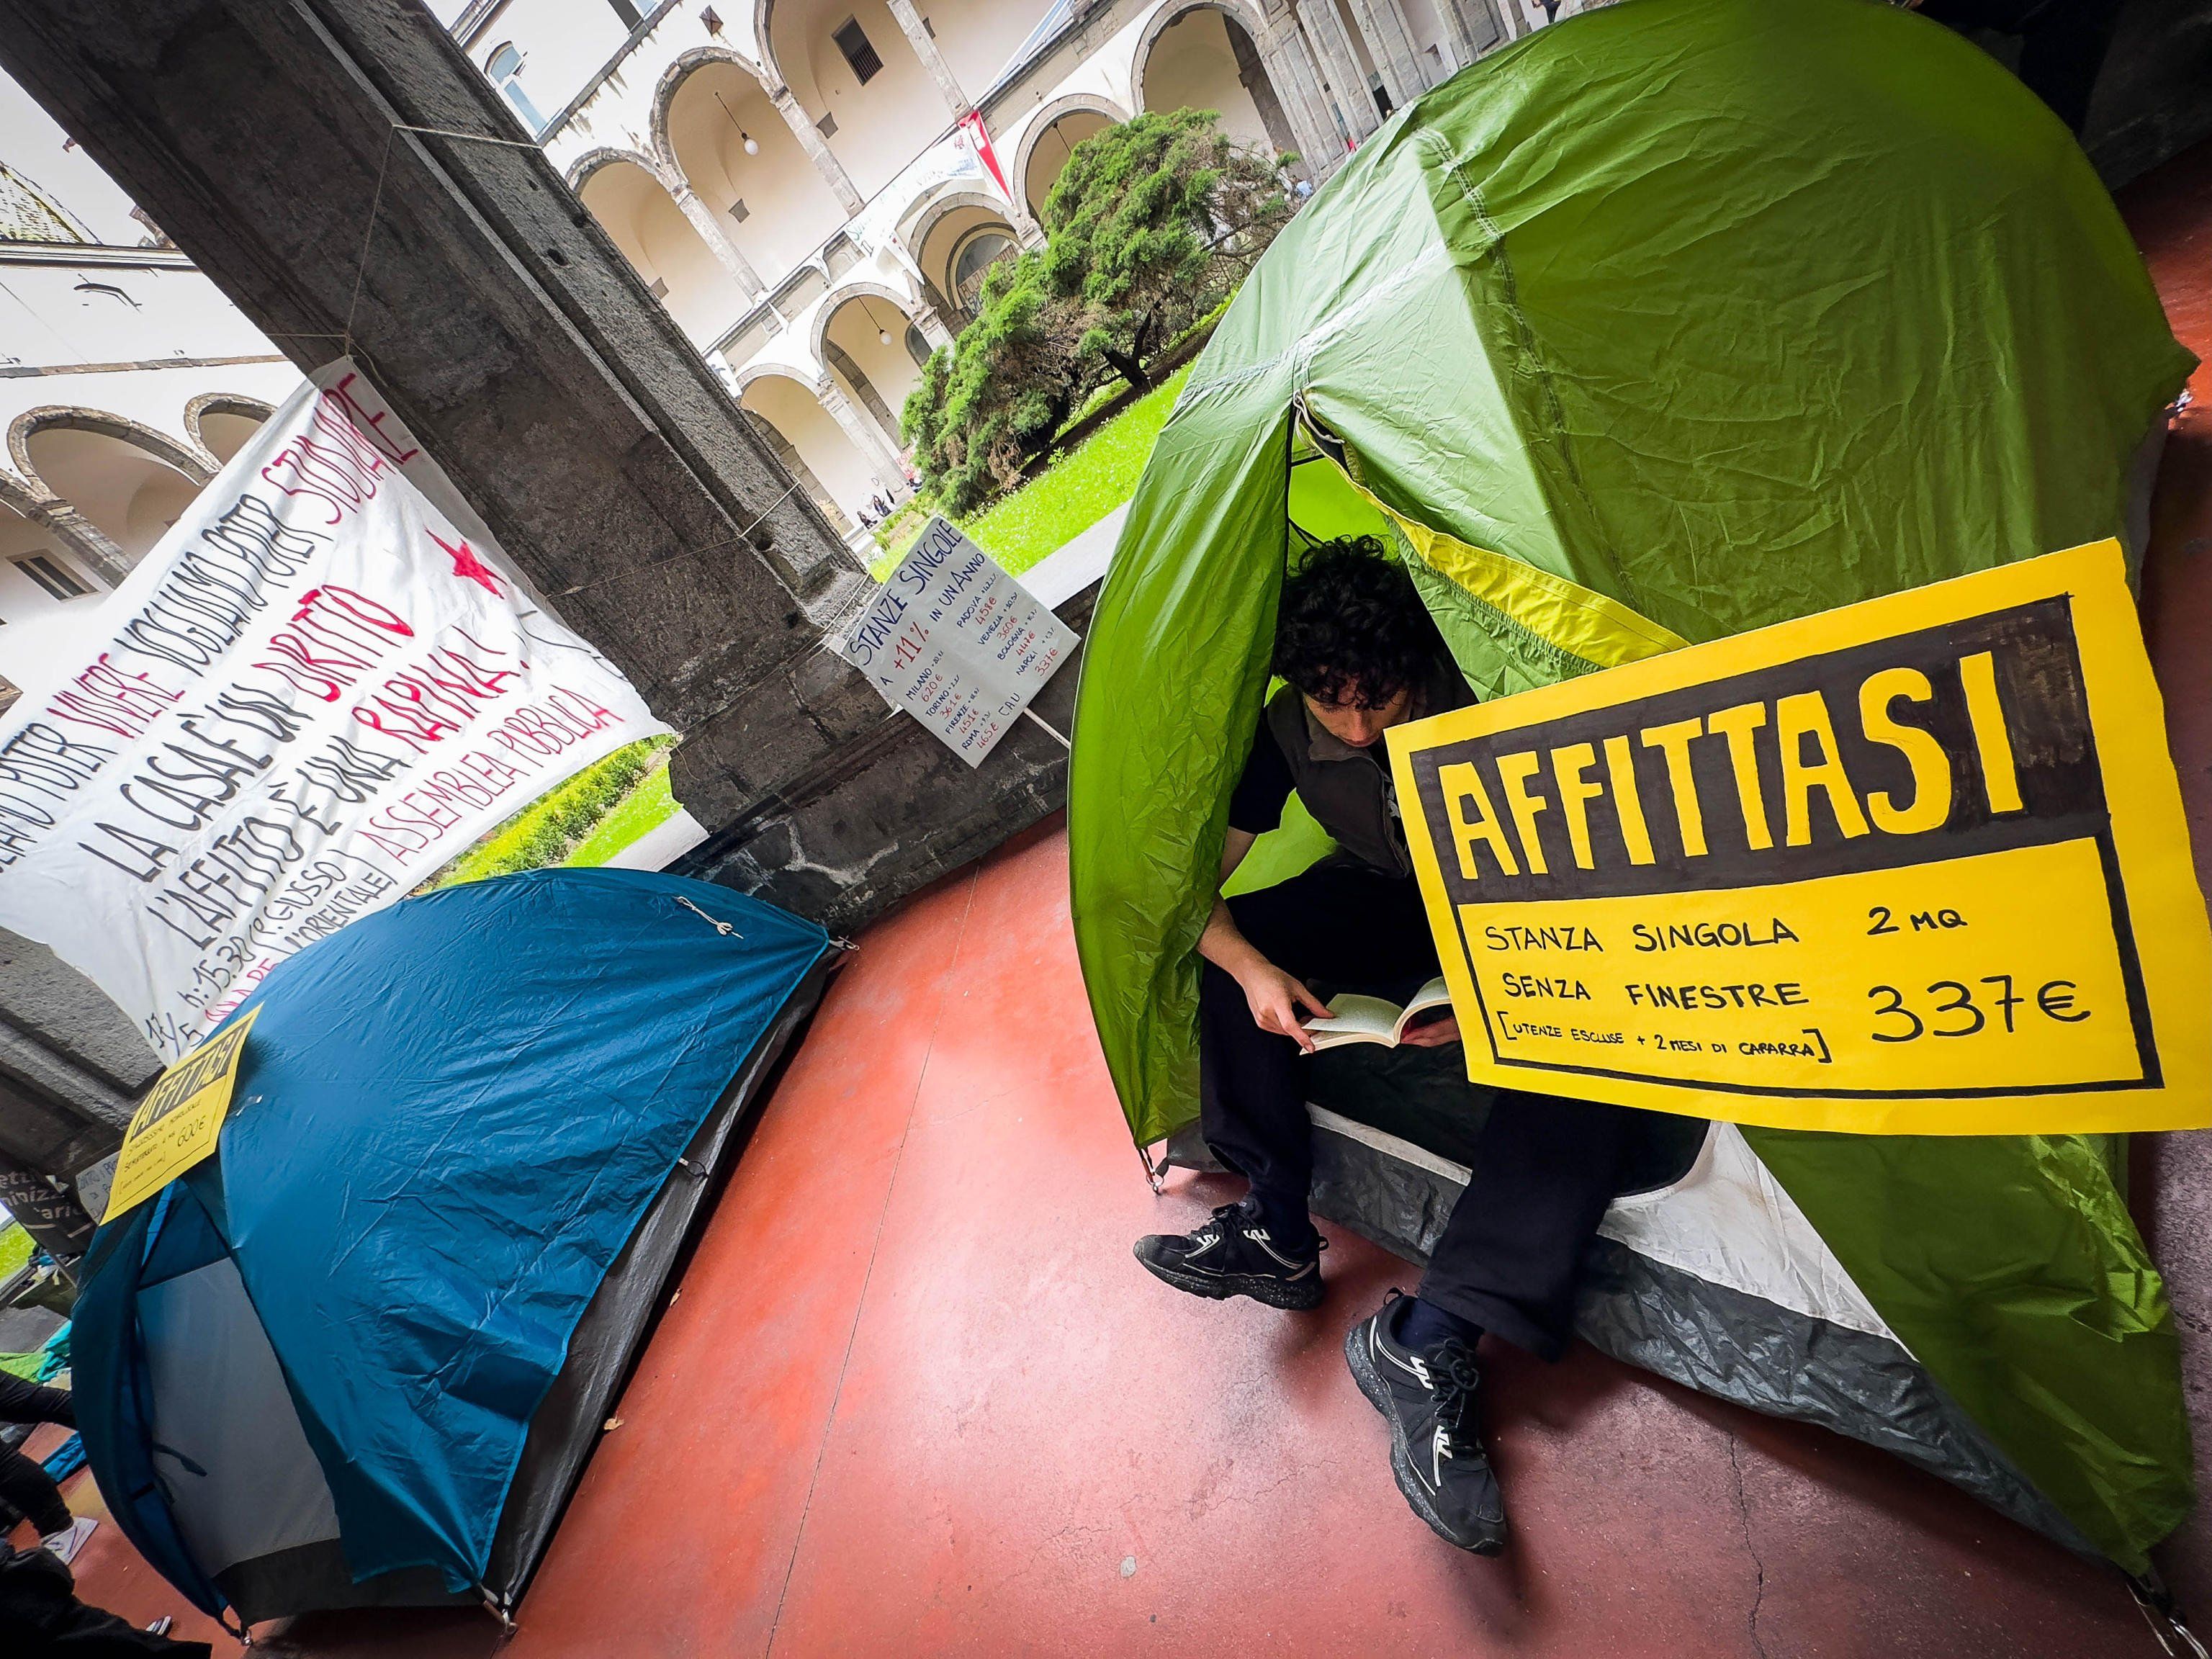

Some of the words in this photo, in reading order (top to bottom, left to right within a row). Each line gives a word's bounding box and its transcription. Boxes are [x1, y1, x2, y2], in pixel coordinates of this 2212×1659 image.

[262, 374, 417, 525] STUDIARE
[201, 494, 333, 588] POTER
[850, 588, 907, 665] STANZE
[899, 520, 963, 595] SINGOLE
[113, 552, 268, 677] VOGLIAMO
[881, 677, 893, 685] A
[930, 608, 943, 621] IN
[939, 585, 959, 606] UN
[950, 554, 984, 592] ANNO
[957, 596, 981, 628] PADOVA
[976, 597, 997, 624] 458€
[978, 616, 1003, 644] VENEZIA
[997, 616, 1017, 639] 360€
[997, 628, 1025, 660] BOLOGNA
[1016, 631, 1035, 655] 447€
[253, 587, 414, 703] DIRITTO
[1016, 651, 1038, 675] NAPOLI
[1035, 648, 1058, 676] 337€
[49, 654, 184, 738] VIVERE
[906, 668, 932, 701] MILANO
[922, 674, 943, 702] 620€
[204, 683, 315, 742] UN
[926, 691, 949, 716] TORINO
[940, 694, 961, 719] 361€
[945, 704, 968, 734] FIRENZE
[959, 709, 979, 734] 451€
[976, 722, 999, 748] 465€
[962, 729, 980, 750] ROMA
[357, 753, 516, 866] ASSEMBLEA
[487, 689, 625, 754] PUBBLICA
[1439, 651, 2023, 881] AFFITTASI
[120, 742, 256, 831] CASA
[77, 823, 179, 883] LA
[145, 817, 304, 950] L'AFFITTO
[296, 736, 413, 801] UNA
[1485, 927, 1603, 952] STANZA
[1633, 918, 1799, 951] SINGOLA
[1867, 907, 1899, 935] 2
[1503, 973, 1591, 999] SENZA
[1625, 984, 1809, 1010] FINESTRE
[1869, 975, 2091, 1042] 337€
[1571, 1029, 1624, 1043] ESCLUSE
[1637, 1036, 1645, 1045] +
[1655, 1035, 1667, 1049] 2
[1670, 1040, 1702, 1051] MESI
[1712, 1043, 1726, 1053] DI
